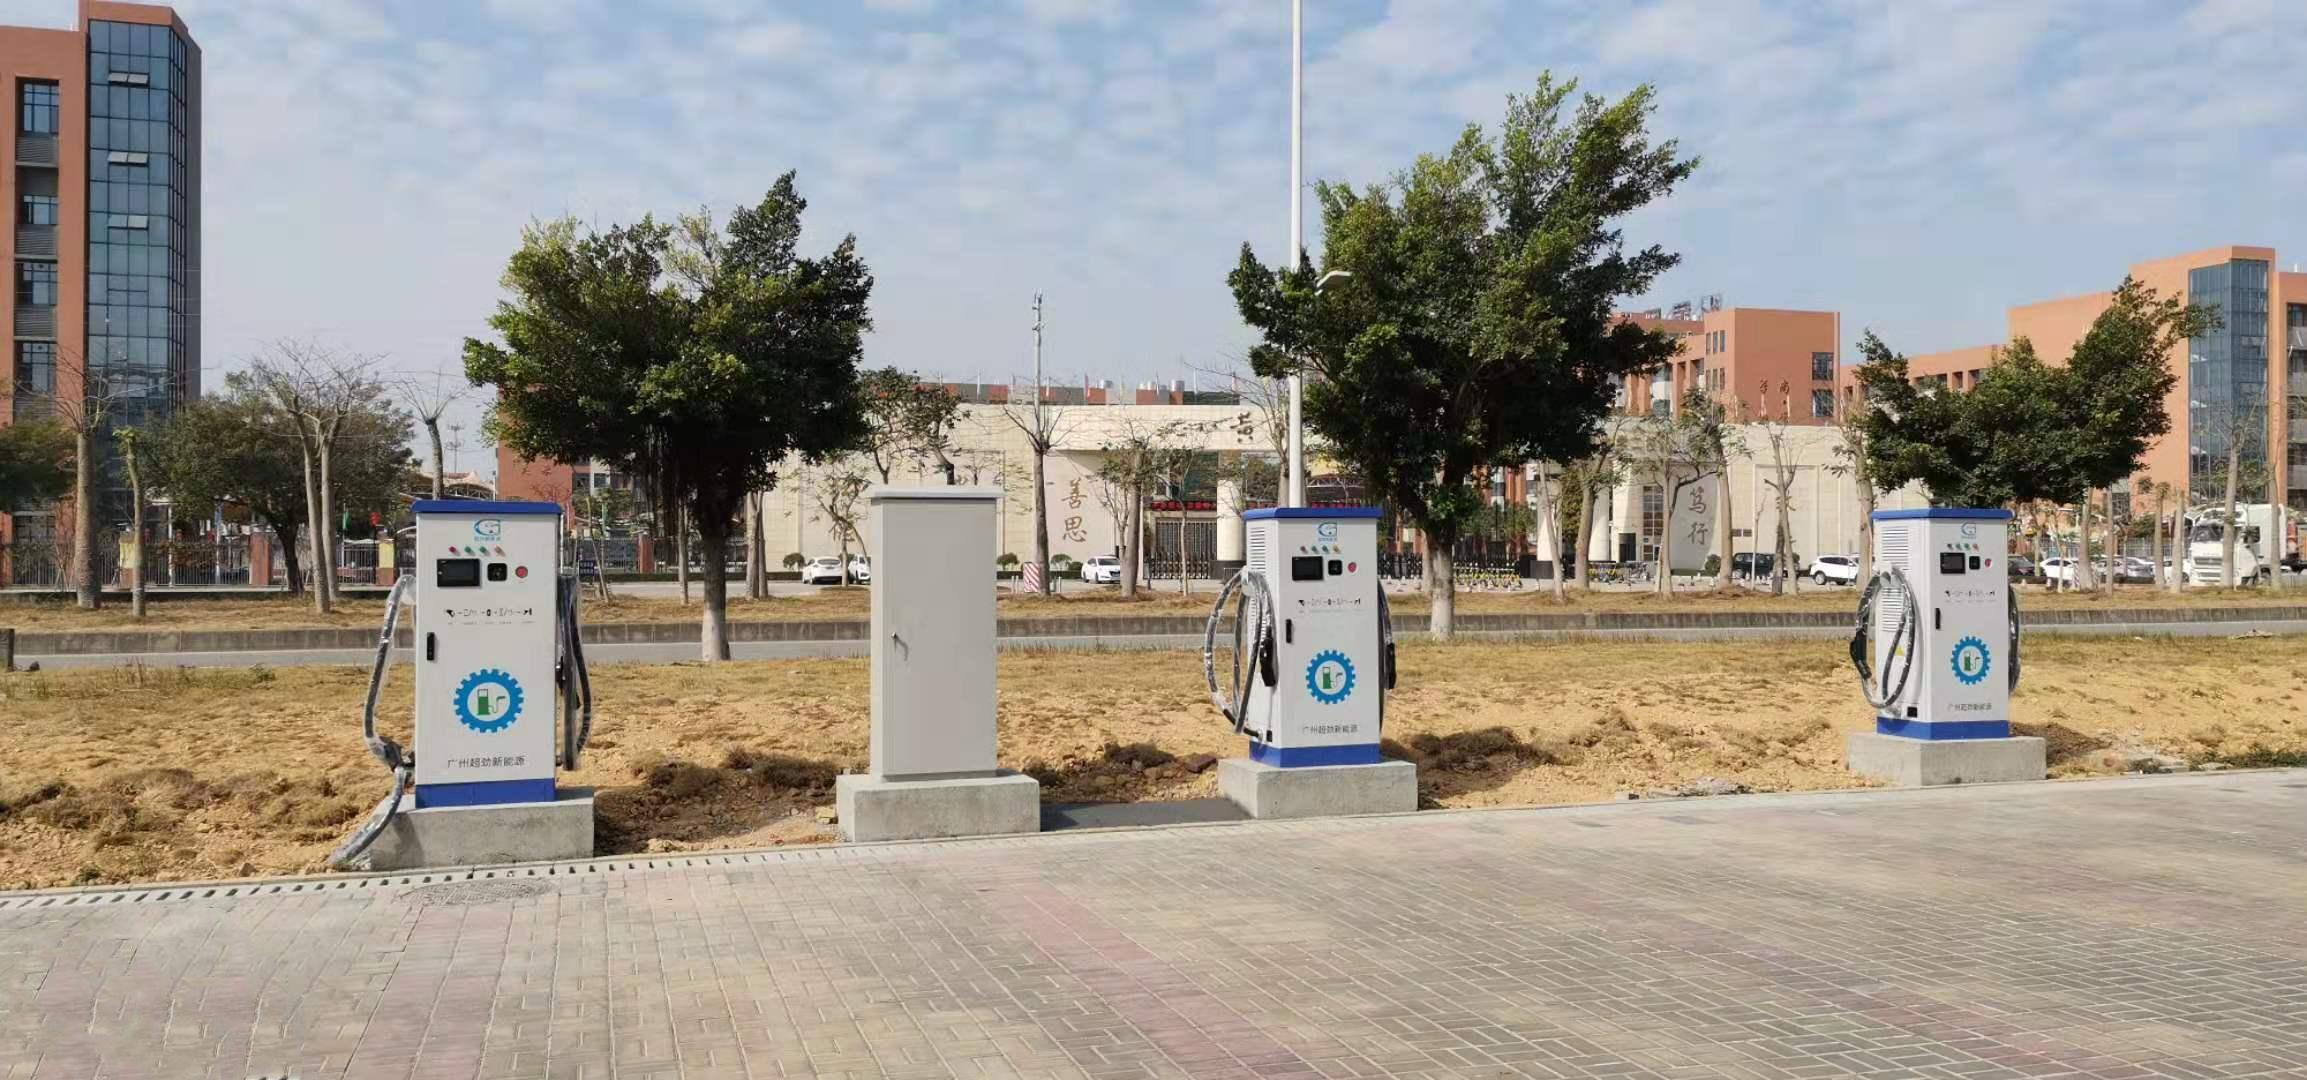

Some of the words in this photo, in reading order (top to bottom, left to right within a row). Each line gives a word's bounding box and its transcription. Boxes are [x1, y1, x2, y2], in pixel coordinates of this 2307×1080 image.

[1061, 477, 1088, 543] 善思
[1687, 486, 1709, 545] 笃行
[447, 755, 525, 769] 广州超劲新能源
